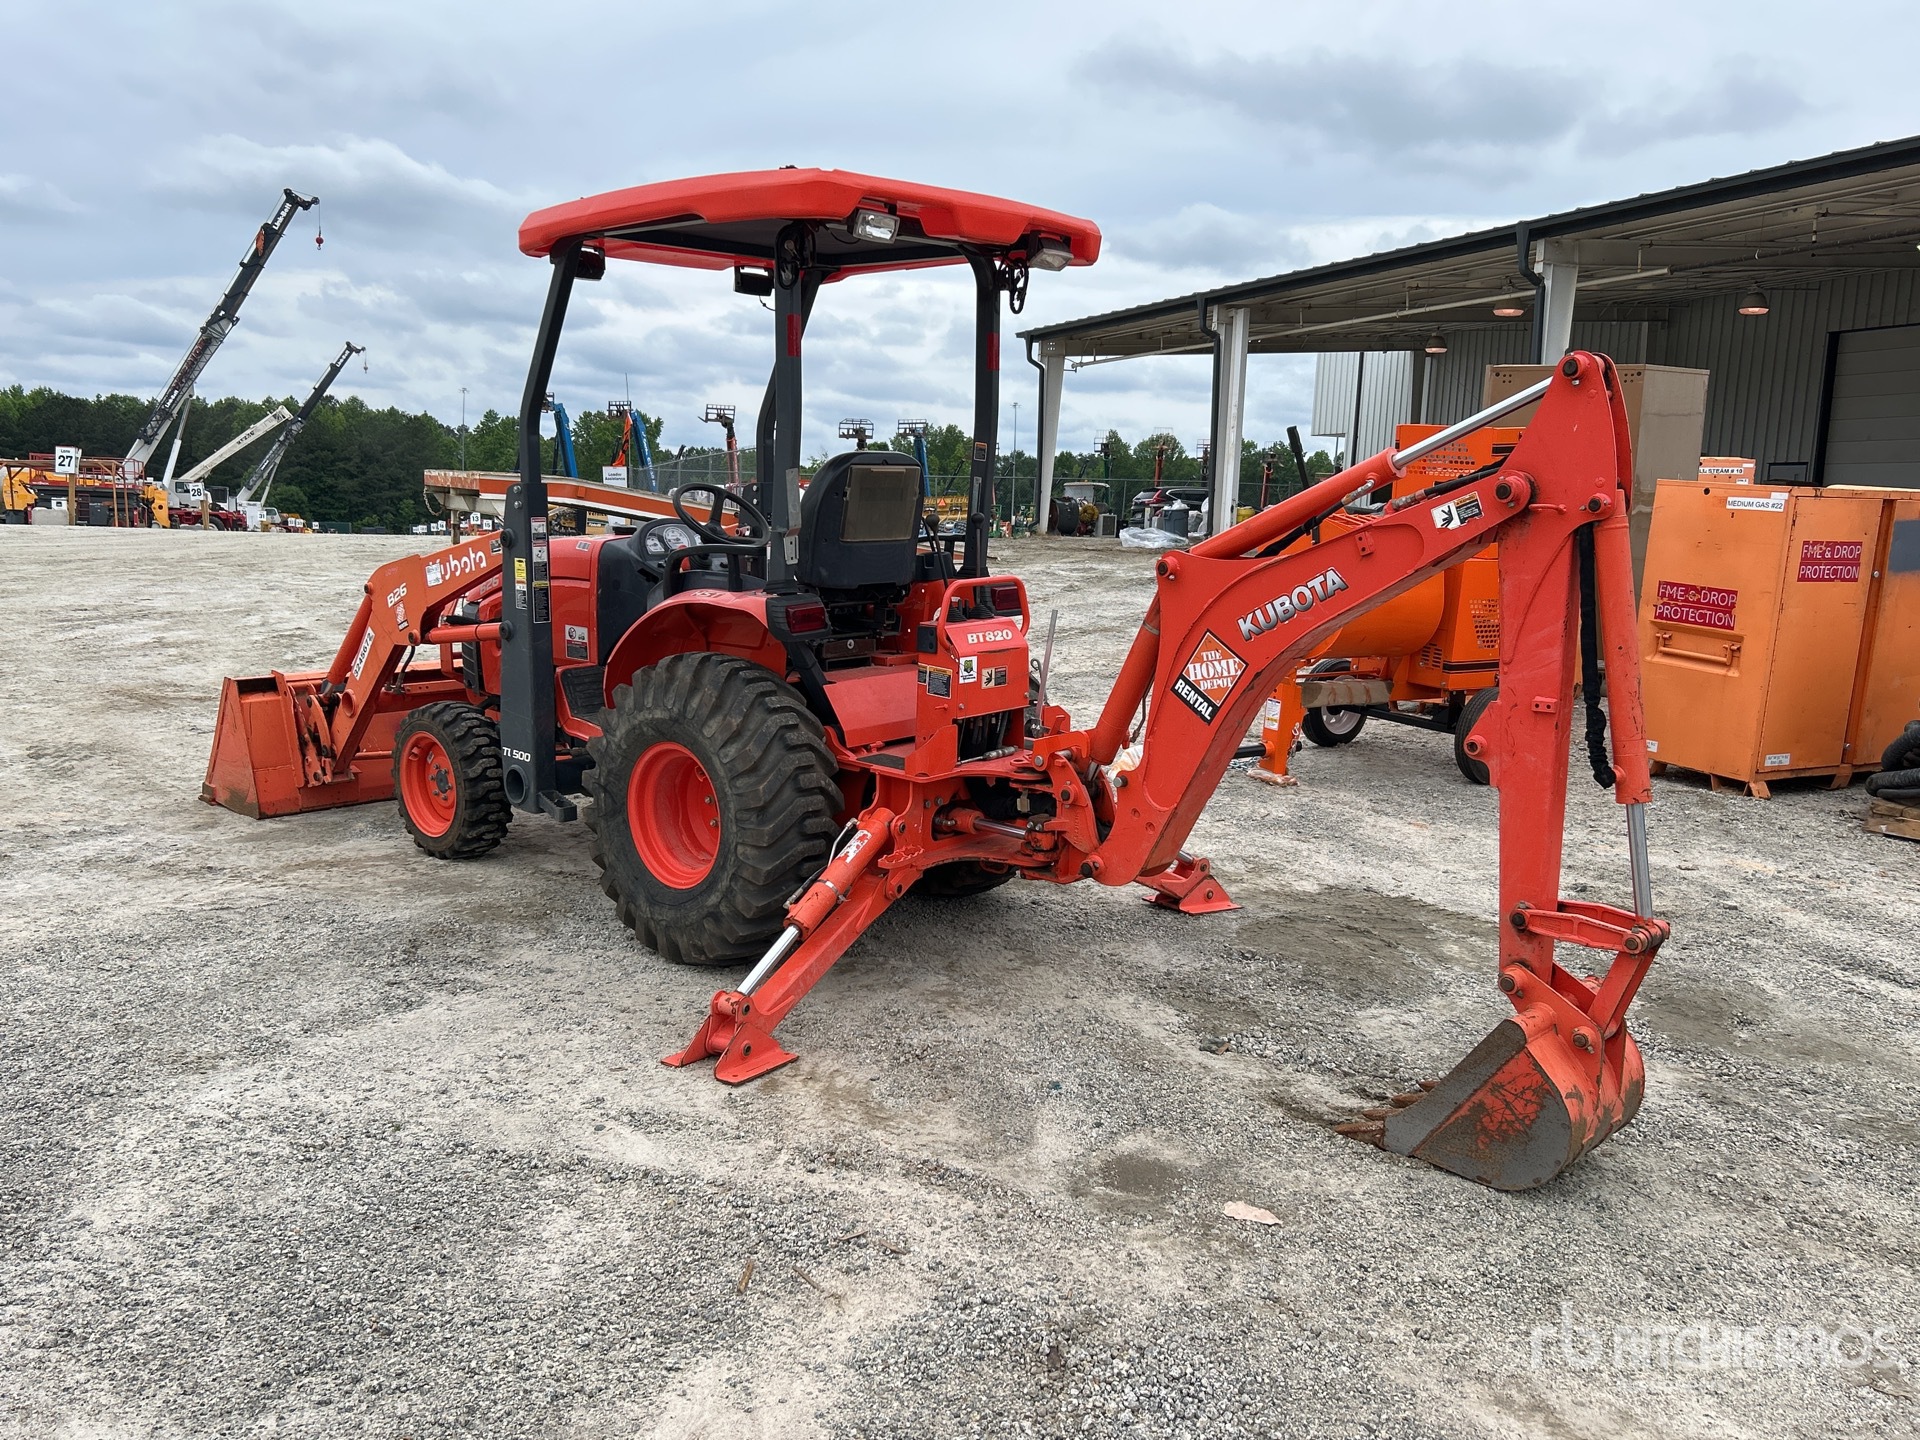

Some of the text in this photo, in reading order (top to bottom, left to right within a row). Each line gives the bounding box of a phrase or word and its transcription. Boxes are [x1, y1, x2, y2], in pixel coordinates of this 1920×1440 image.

[57, 454, 74, 468] 27
[191, 487, 202, 497] 28
[1727, 500, 1783, 510] MEDIUM GAS #22
[1801, 544, 1862, 560] FME & DROP
[429, 547, 488, 580] ubota
[1798, 564, 1860, 580] PROTECTION
[386, 582, 408, 608] B26
[1659, 583, 1686, 600] FME
[1700, 590, 1737, 607] DROP
[1236, 568, 1349, 641] KUBOTA
[1655, 603, 1735, 628] PROTECTION
[966, 629, 1013, 644] BT820
[1200, 649, 1223, 662] THE
[1187, 658, 1242, 681] HOME
[1199, 676, 1233, 691] DEPOT
[1174, 678, 1214, 720] RENTAL
[512, 749, 531, 763] 500
